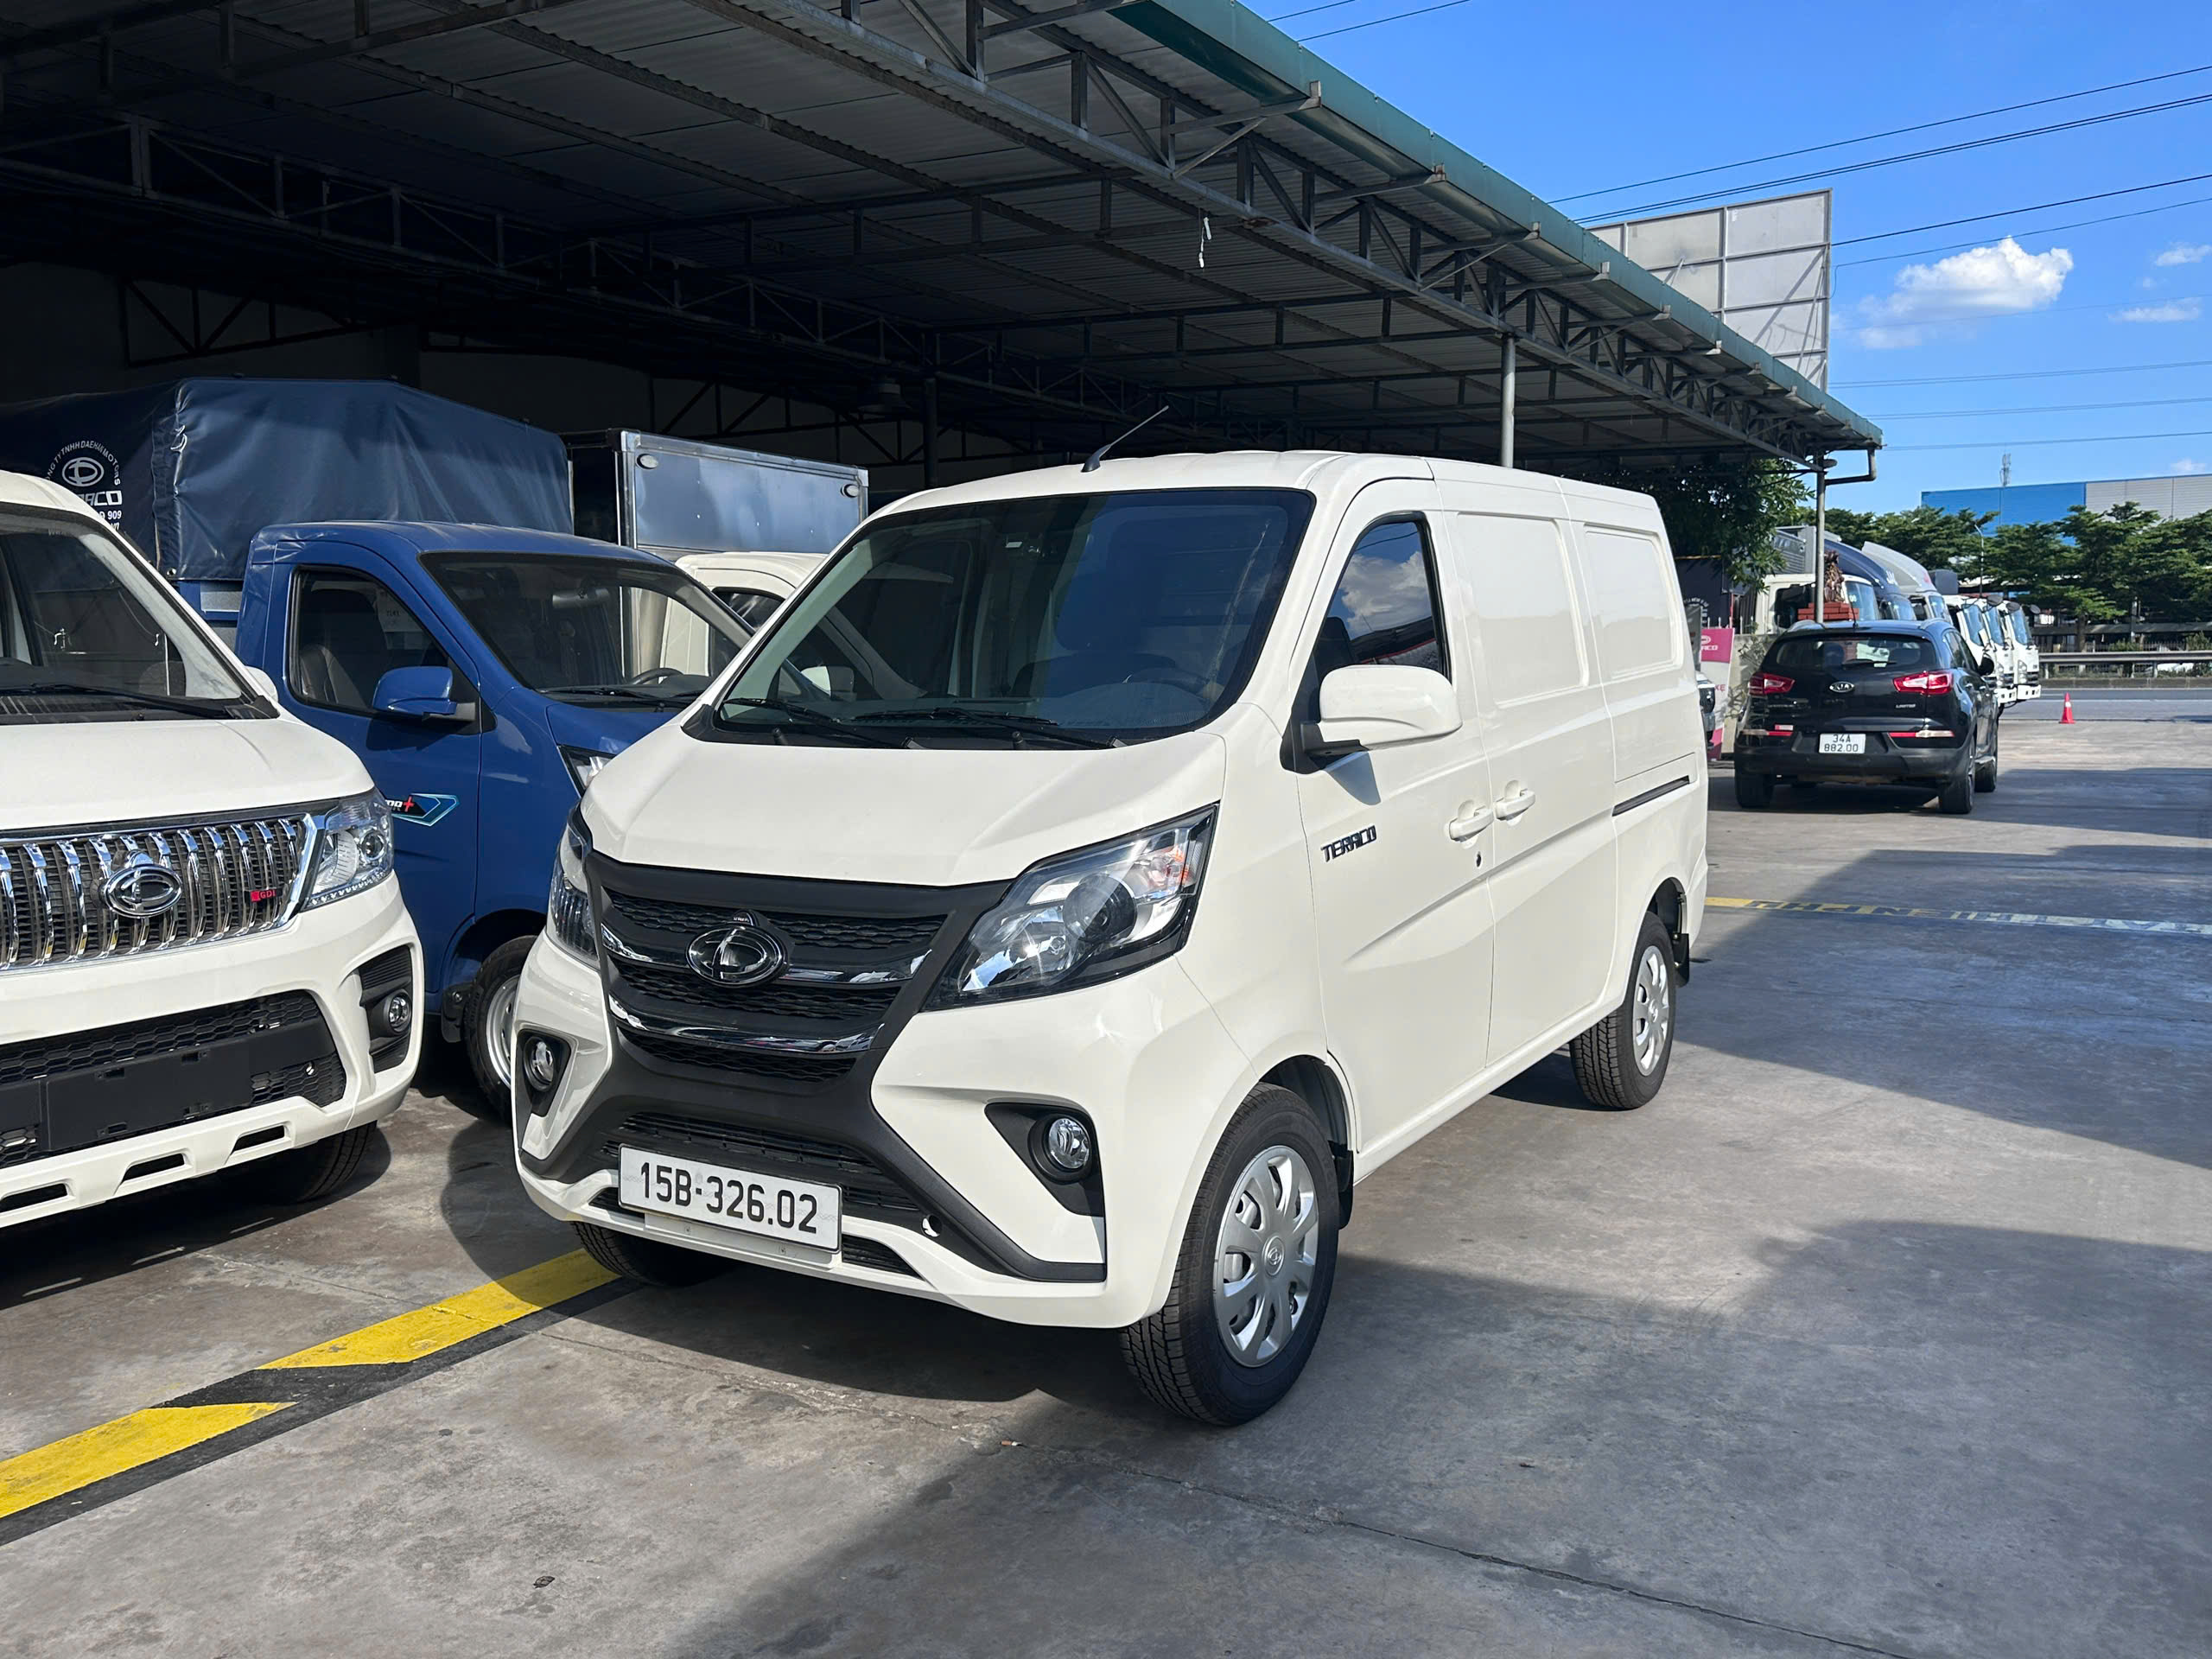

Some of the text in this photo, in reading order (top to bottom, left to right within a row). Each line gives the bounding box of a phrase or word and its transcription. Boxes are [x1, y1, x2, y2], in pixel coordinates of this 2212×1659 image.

[54, 453, 62, 463] TY
[60, 442, 80, 455] TNHH
[80, 441, 105, 453] DAEHAN
[102, 448, 121, 486] MOTORS
[1823, 743, 1859, 753] 882.00
[1832, 734, 1852, 743] 34A
[1320, 824, 1377, 862] TERACO
[640, 1161, 817, 1234] 15B-326.02
